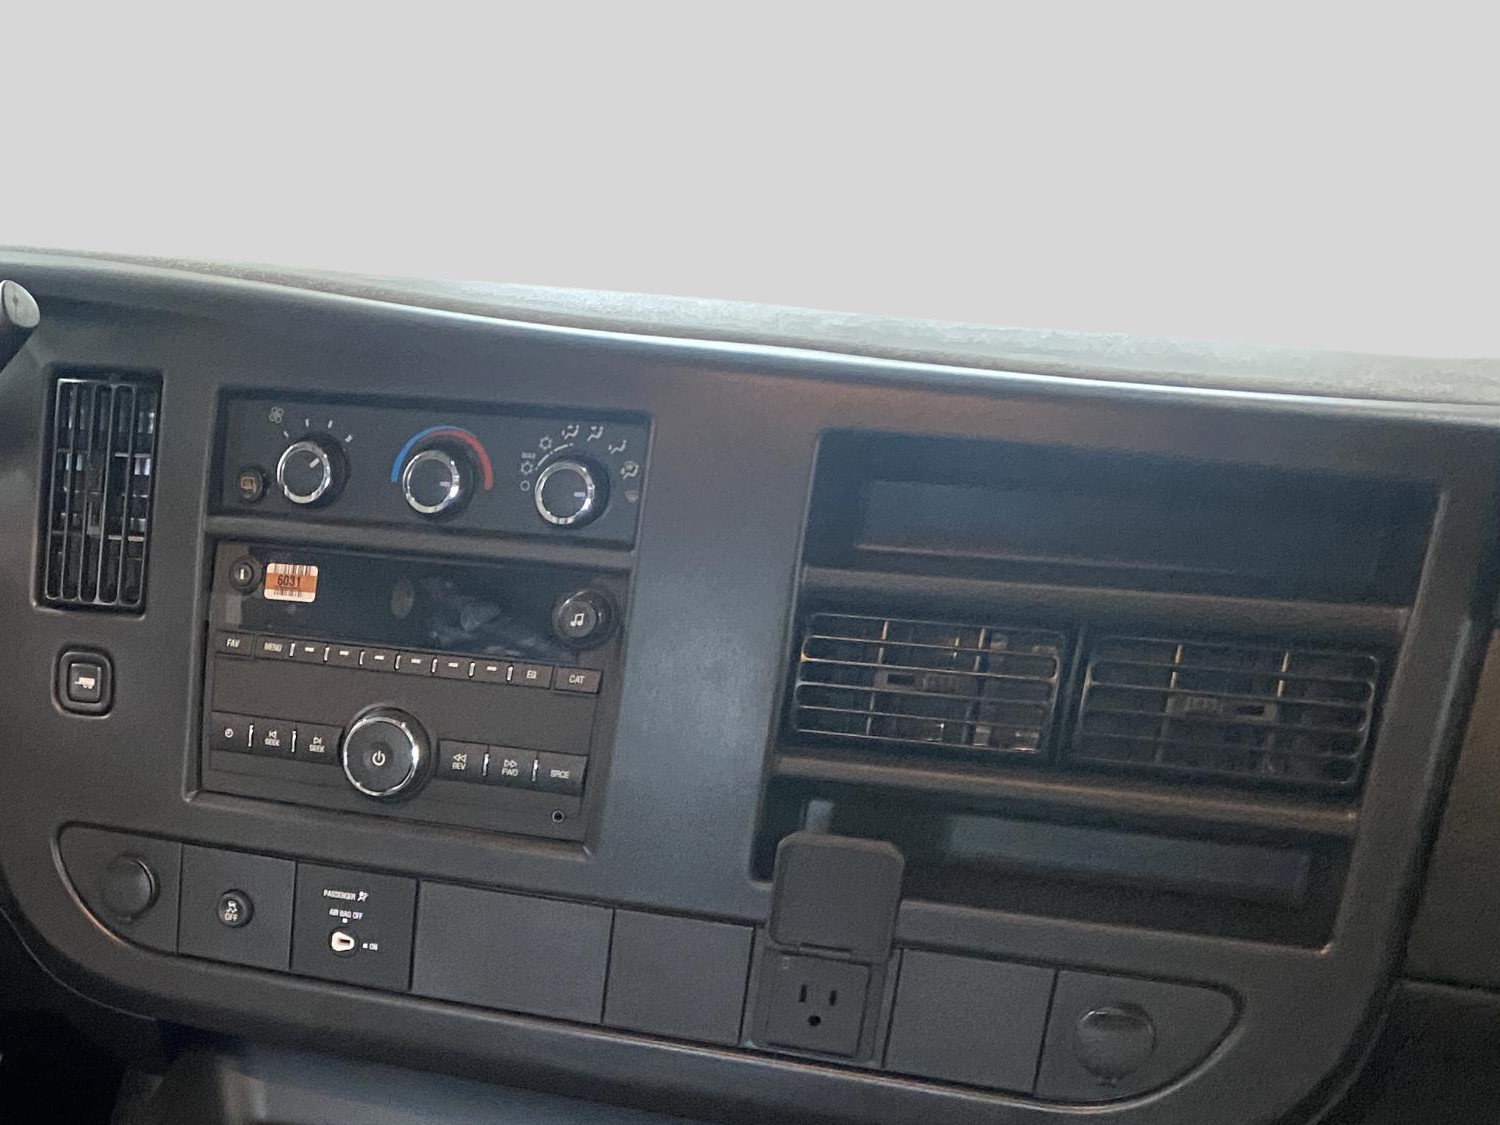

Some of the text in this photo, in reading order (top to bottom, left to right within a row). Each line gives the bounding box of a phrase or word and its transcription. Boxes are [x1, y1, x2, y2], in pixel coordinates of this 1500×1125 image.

[277, 574, 301, 587] 6031
[227, 639, 240, 648] FAV
[263, 642, 283, 652] MENU
[569, 675, 585, 684] CAT
[265, 738, 280, 747] SEEK
[309, 744, 325, 753] SEEK
[452, 762, 466, 771] REV
[501, 768, 519, 777] FWD
[550, 769, 570, 779] SRCE
[323, 889, 356, 901] PASSENGER
[224, 912, 238, 921] OFF
[352, 911, 363, 920] OFF
